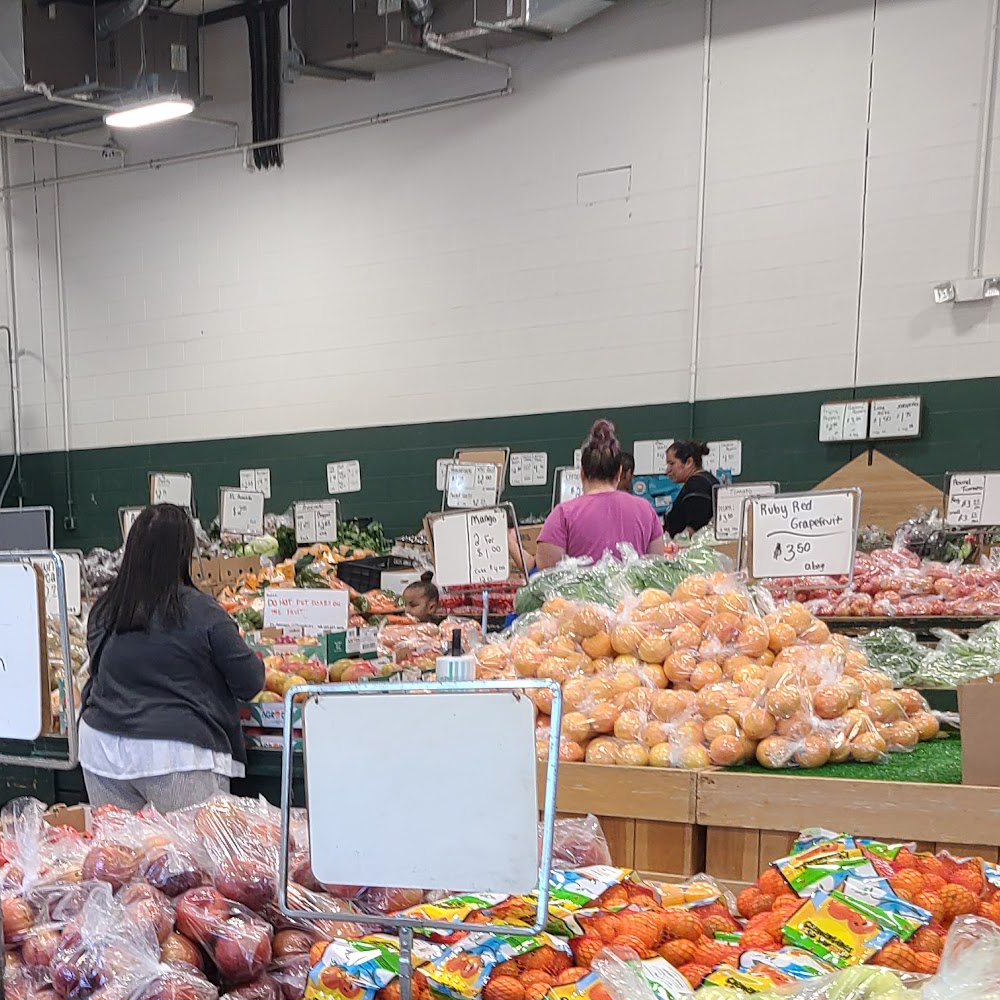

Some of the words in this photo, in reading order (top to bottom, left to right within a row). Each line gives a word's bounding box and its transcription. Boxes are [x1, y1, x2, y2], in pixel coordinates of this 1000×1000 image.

[760, 503, 788, 519] Ruby
[792, 499, 813, 513] Red
[470, 514, 497, 527] Mango
[790, 514, 843, 530] Grapefruit
